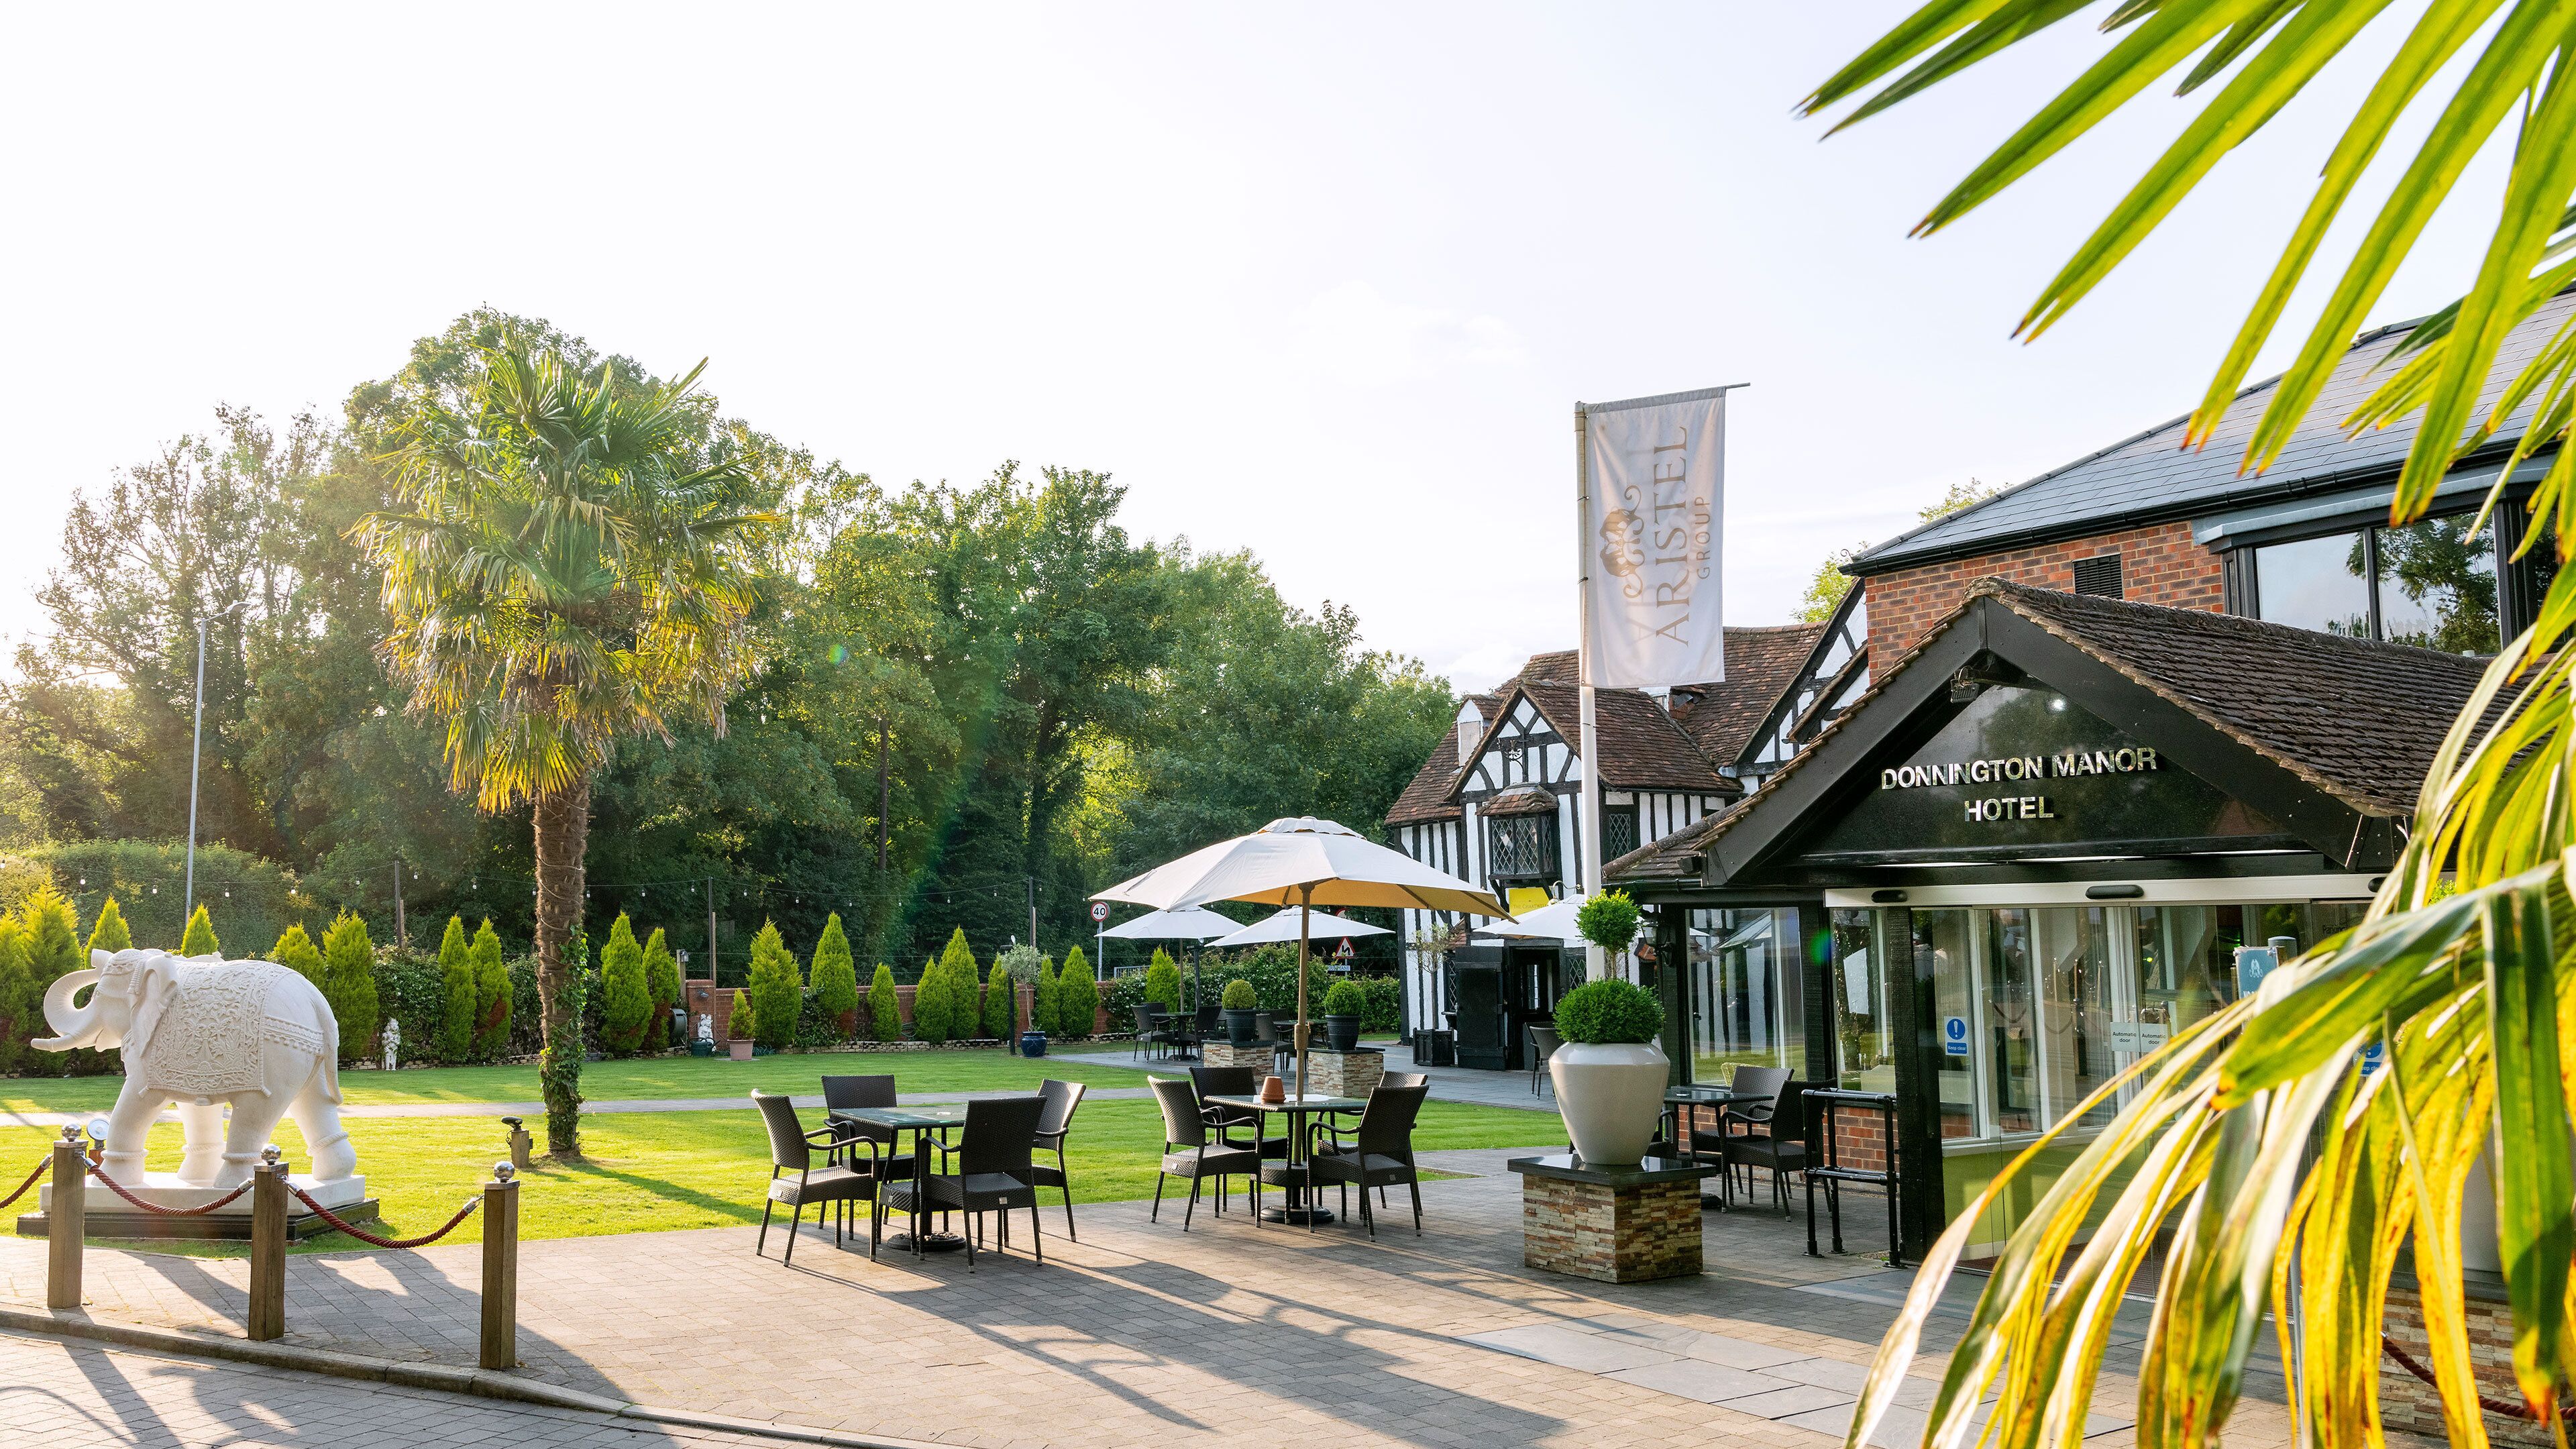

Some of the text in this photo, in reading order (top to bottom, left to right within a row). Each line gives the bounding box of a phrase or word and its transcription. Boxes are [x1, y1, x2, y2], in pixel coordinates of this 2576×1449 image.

[1653, 426, 1690, 648] ARISTEL
[1694, 496, 1711, 580] GROUP
[1881, 747, 2157, 790] DONNINGTON MANOR
[1964, 796, 2055, 822] HOTEL
[1093, 907, 1106, 916] 40
